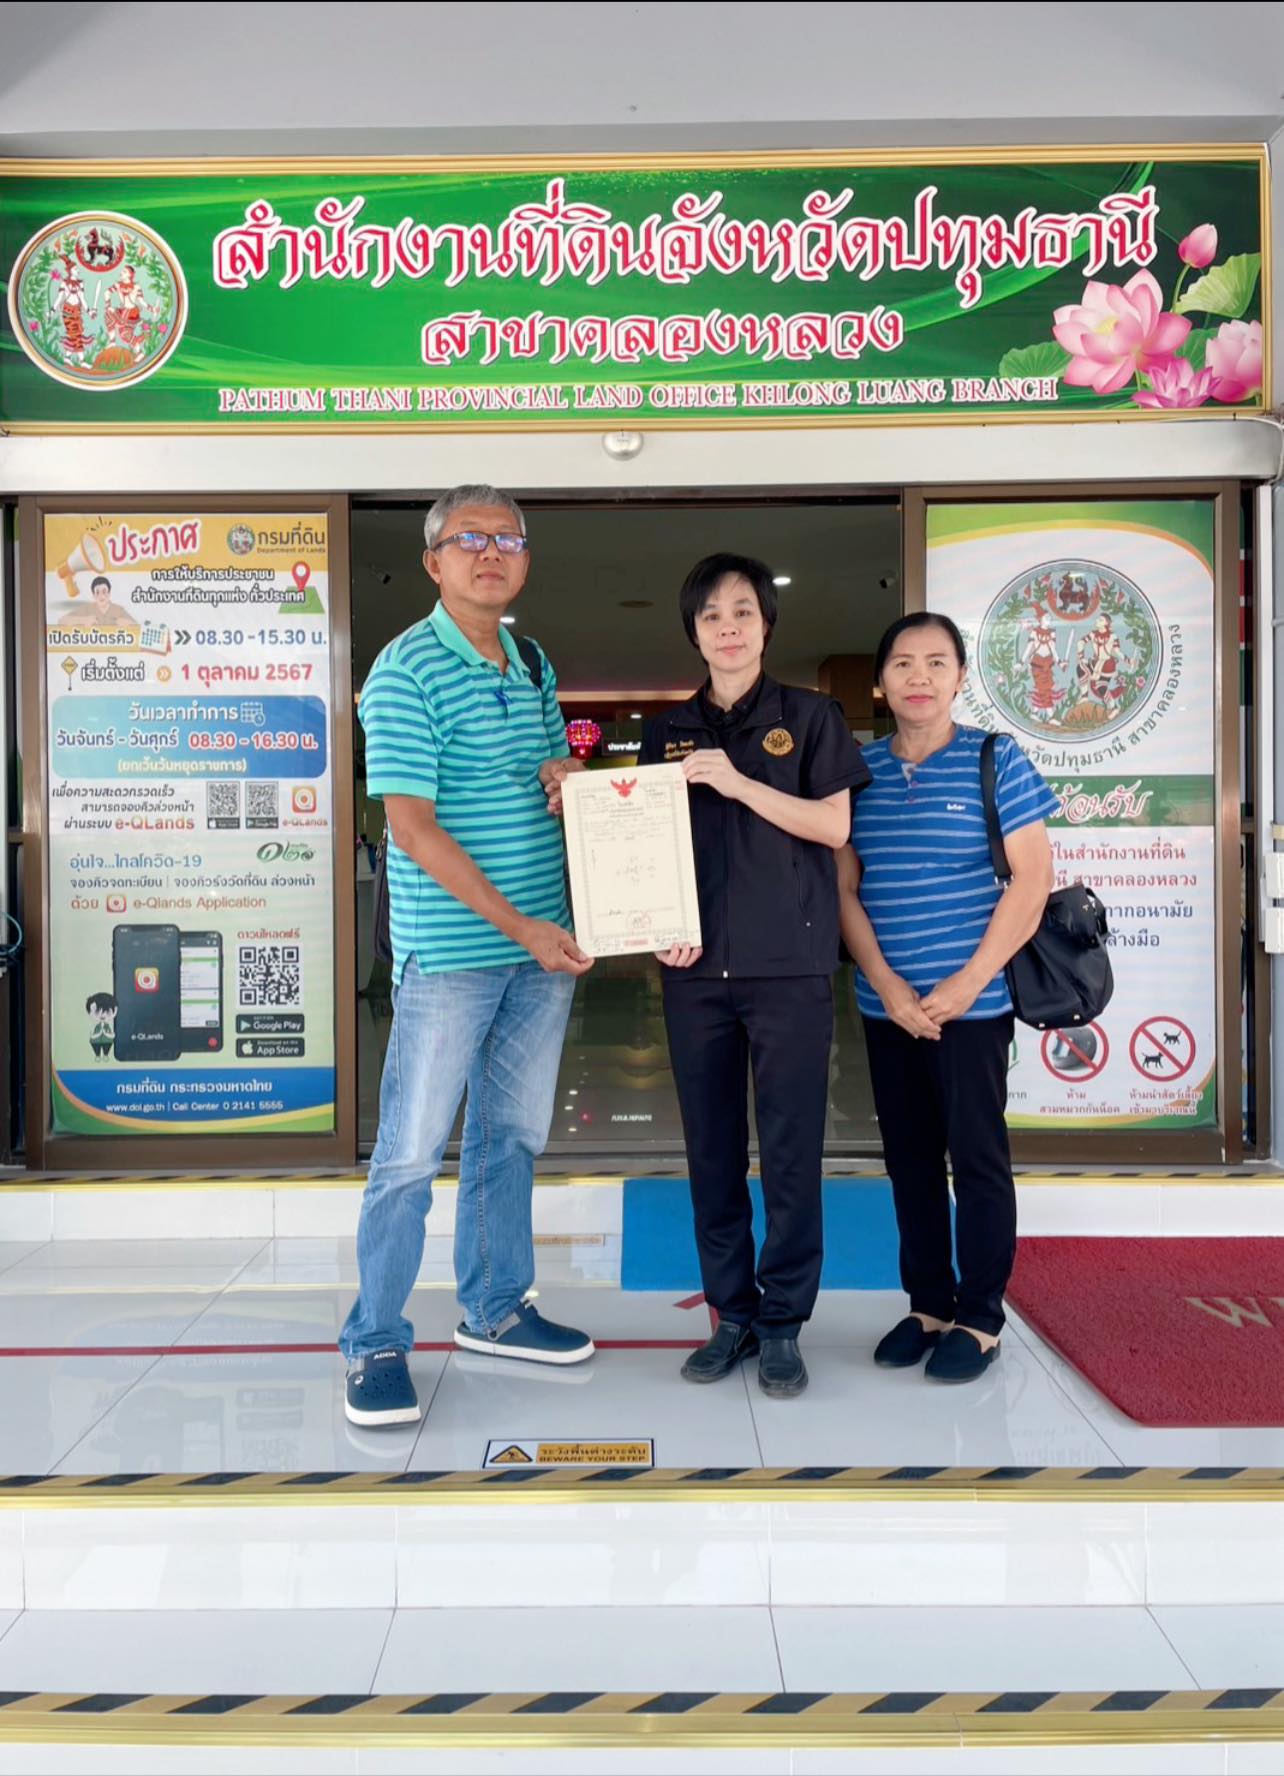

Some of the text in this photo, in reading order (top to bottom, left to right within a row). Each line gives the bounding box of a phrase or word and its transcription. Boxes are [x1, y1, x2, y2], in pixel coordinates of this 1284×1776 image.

[212, 178, 1158, 308] สำนักงานที่ดินจังหวัดปทุมธานี
[420, 305, 904, 366] สาขาคลองหลวง
[218, 377, 1058, 412] PATHUM THANI PROVINCIAL LAND OFFICE KHLONG LUANG BRANCH
[107, 518, 201, 563] ประกาศ
[258, 522, 325, 545] กรมที่ดิน
[152, 565, 275, 581] การให้บริการประชาชน
[49, 629, 134, 645] เปิดรับบัตรคิว
[181, 664, 313, 687] 1 ตุลาคม 2567
[128, 701, 238, 723] วันเวลาทำการ
[57, 730, 114, 747] วันจันทร์
[129, 728, 178, 752] วันศุกร์
[64, 816, 195, 830] ผ่านระบบ e-QLands
[1050, 837, 1186, 860] ในสำนักงานที่ดิน
[71, 896, 99, 909] ด้วย
[196, 896, 266, 912] Application
[253, 1020, 301, 1031] Google Play
[257, 1045, 299, 1056] App Store
[117, 1077, 272, 1094] กรมที่ดิน กระทรวงมหาดไทย
[172, 1102, 188, 1111] Call
[191, 1102, 219, 1111] Center
[619, 1455, 645, 1463] STEP
